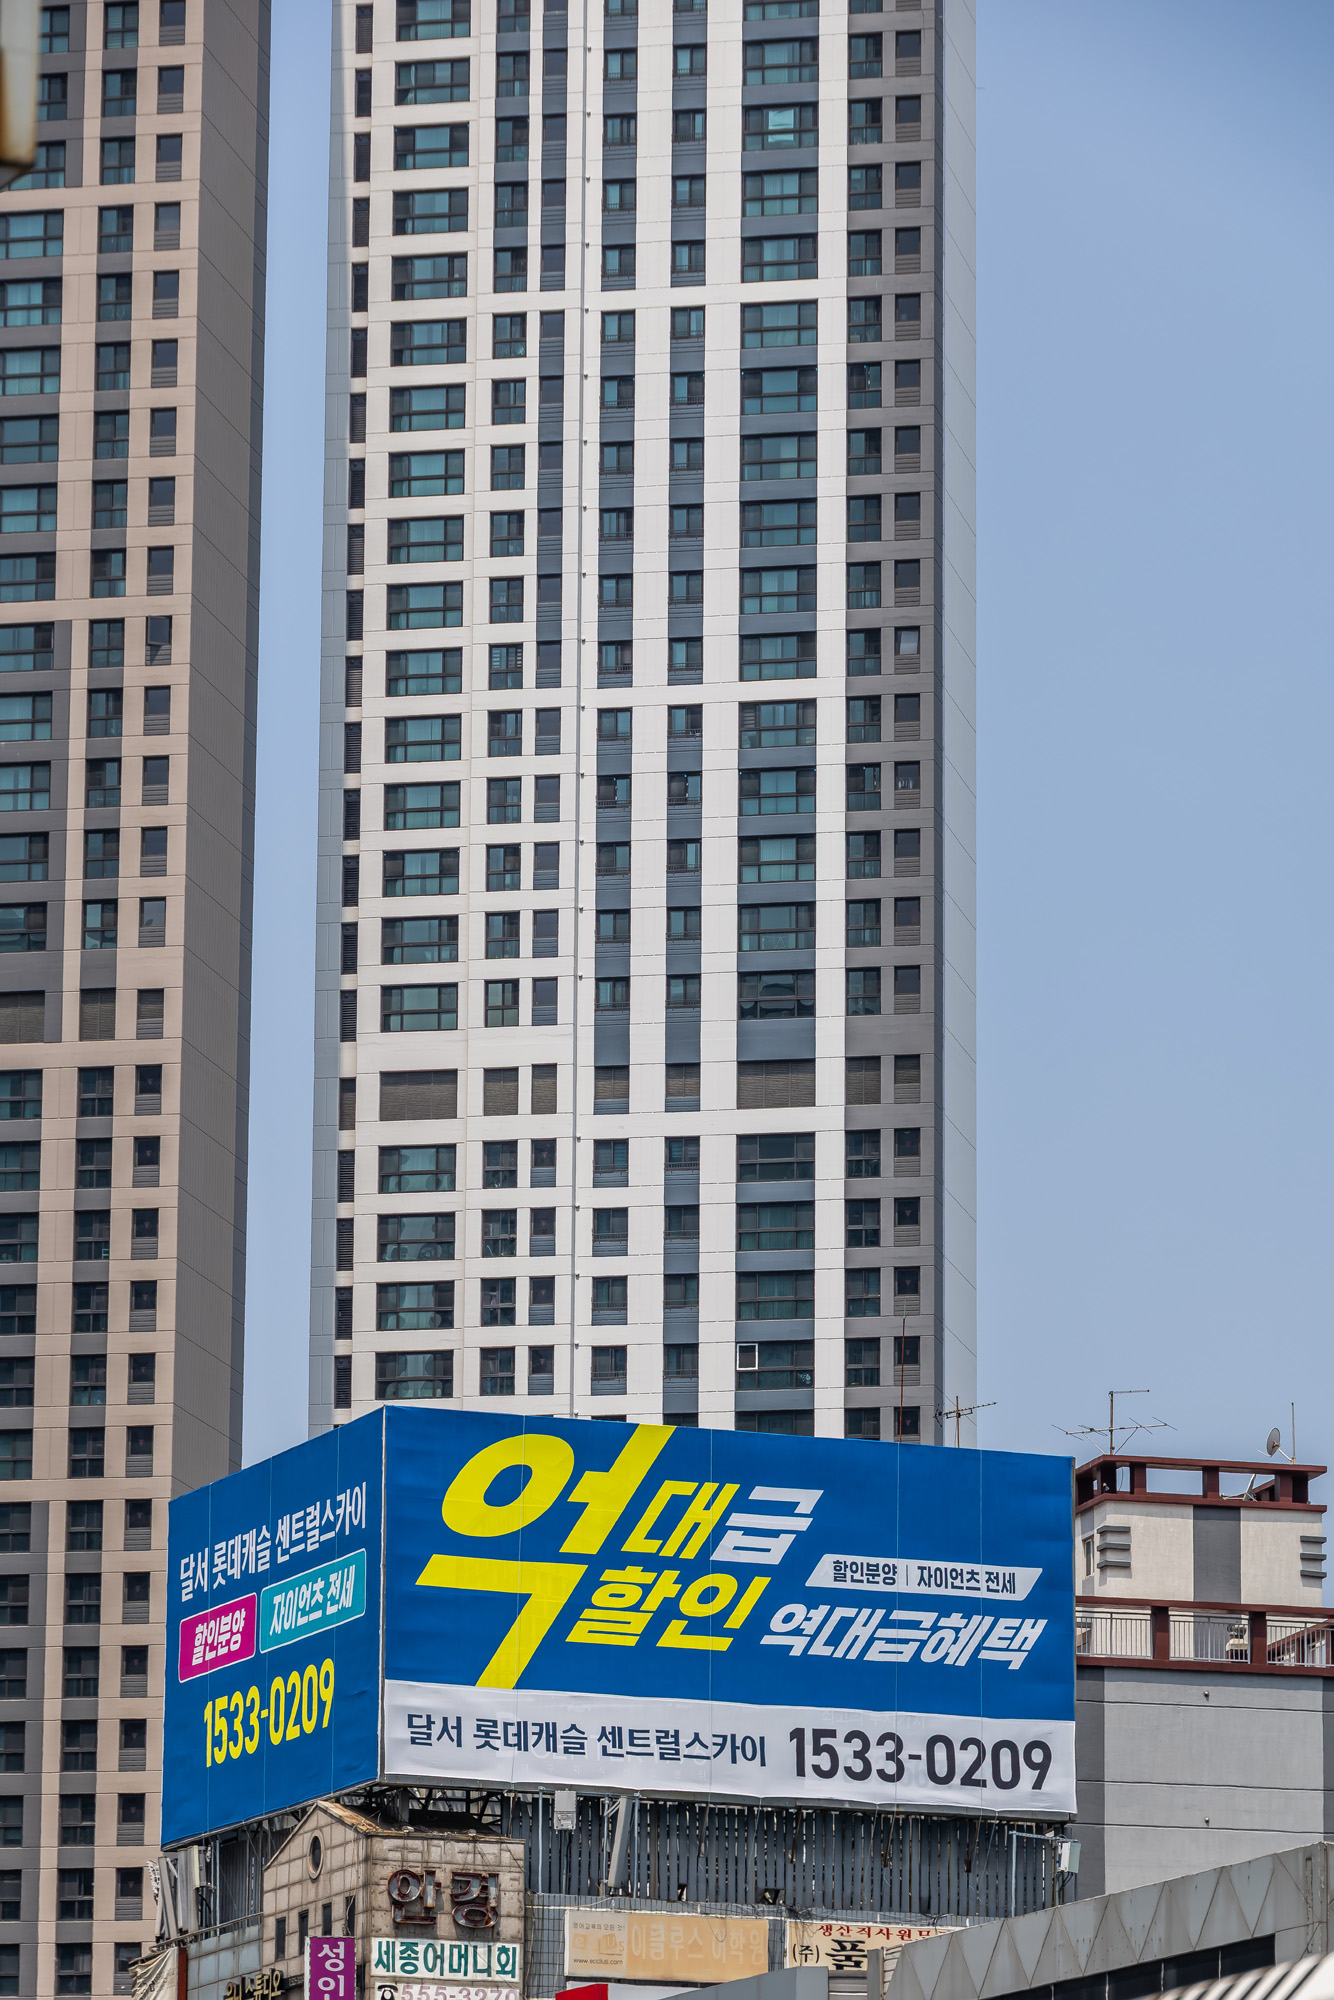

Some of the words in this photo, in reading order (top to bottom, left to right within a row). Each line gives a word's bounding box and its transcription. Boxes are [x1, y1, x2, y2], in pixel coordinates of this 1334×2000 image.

[180, 1548, 208, 1602] 달서
[213, 1524, 271, 1590] 롯데캐슬
[275, 1482, 366, 1564] 센트럴스카이
[269, 1577, 324, 1636] 자이언츠
[325, 1564, 356, 1617] 전세
[832, 1559, 898, 1586] 할인분양
[917, 1567, 981, 1592] 자이언츠
[985, 1571, 1016, 1594] 전세
[191, 1607, 246, 1666] 할인분양
[566, 1566, 771, 1652] 할인
[759, 1604, 1048, 1670] 역대급혜택
[203, 1658, 335, 1768] 1533-0209
[408, 1713, 462, 1749] 달서
[474, 1718, 588, 1756] 롯데캐슬
[597, 1725, 767, 1767] 센트럴스카이
[789, 1727, 1053, 1791] 1533-0209
[388, 1869, 500, 1928] 안경
[374, 1940, 517, 1979] 세종어머니회
[631, 1923, 704, 1960] 이클루스
[712, 1927, 764, 1966] 어학원
[817, 1924, 951, 1942] 생산직사원모
